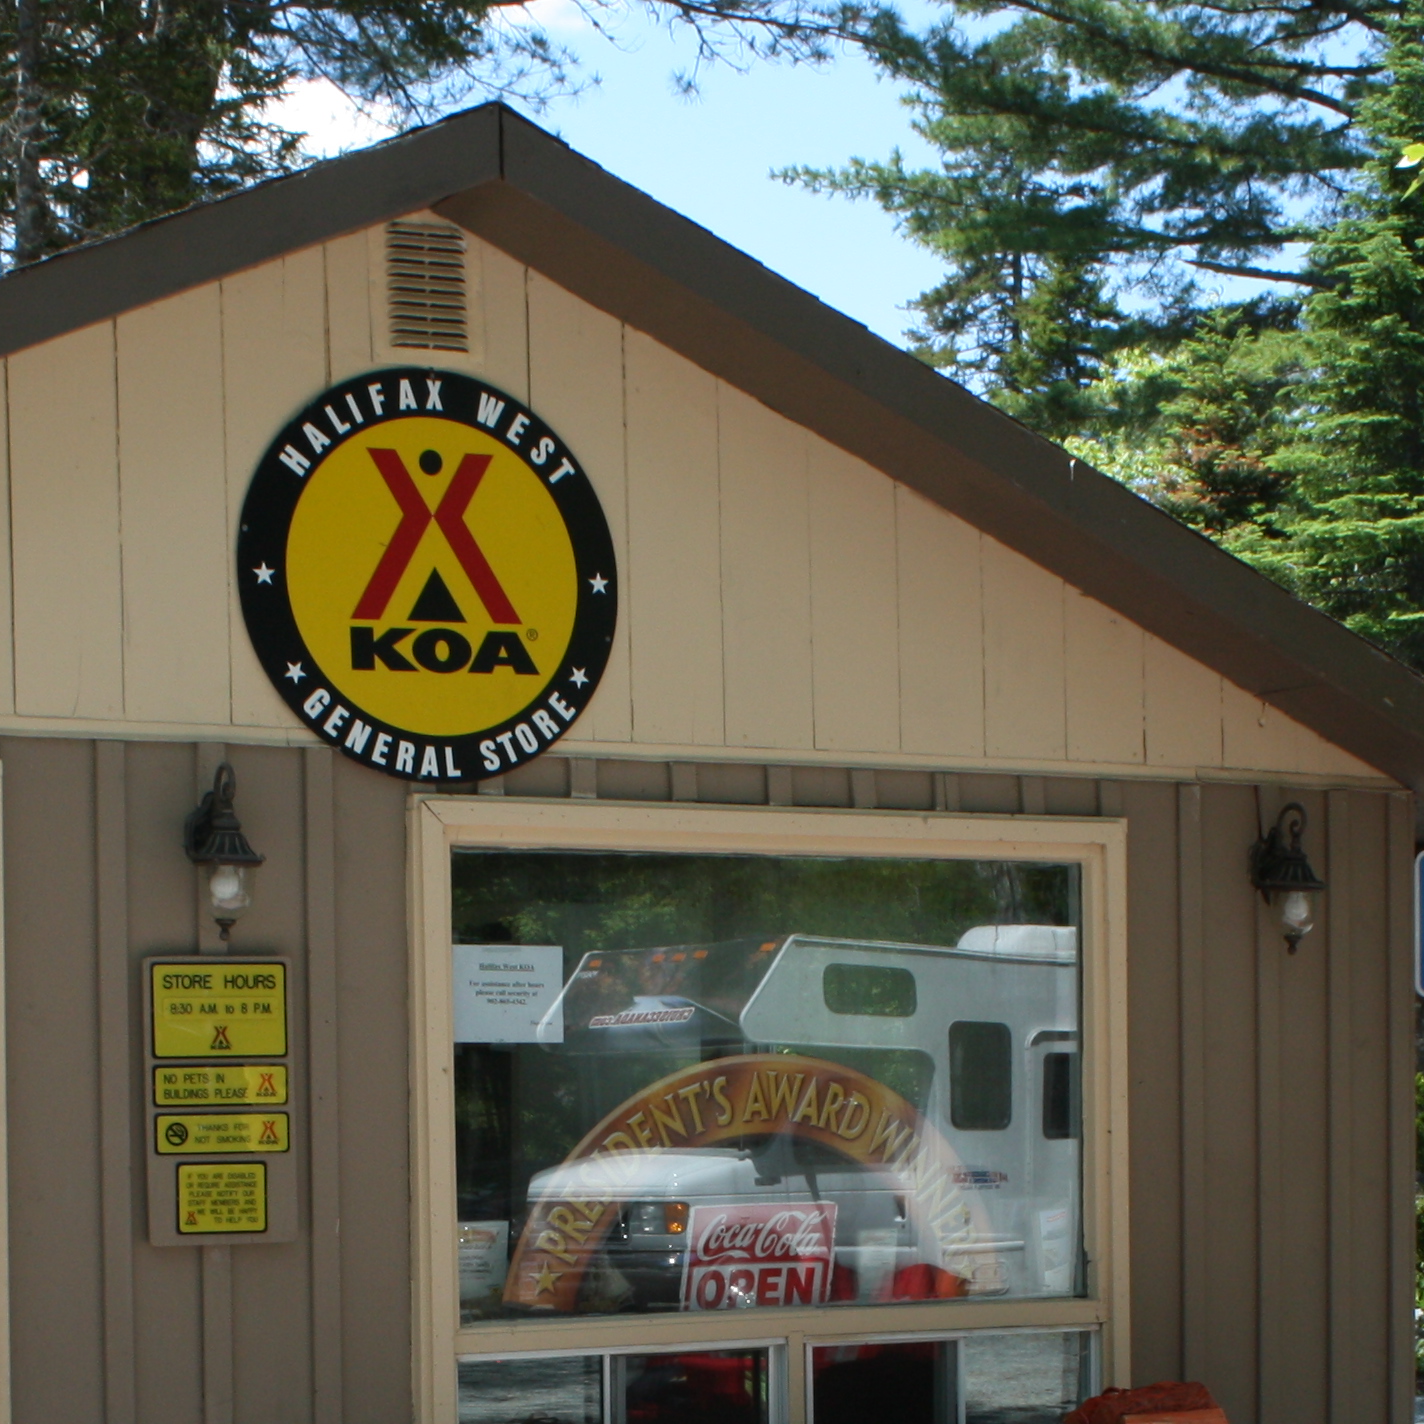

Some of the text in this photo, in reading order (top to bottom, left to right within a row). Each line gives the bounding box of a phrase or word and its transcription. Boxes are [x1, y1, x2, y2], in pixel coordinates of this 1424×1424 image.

[279, 378, 576, 485] HALIFAX WEST
[349, 626, 540, 675] KOA
[303, 688, 576, 778] GENERAL STORE
[163, 975, 276, 990] STORE HOURS
[225, 1003, 234, 1014] to
[241, 1003, 248, 1014] 8
[163, 1074, 225, 1085] NO PETS IN
[163, 1088, 248, 1099] BUILDINGS PLEASE
[194, 1135, 251, 1144] NOT SMOKING
[197, 1123, 249, 1133] THANKS FOR
[534, 1071, 974, 1265] PRESIDENT'S AWARD WINNER
[697, 1210, 829, 1261] Coca-Cola
[696, 1267, 815, 1310] OPEN
